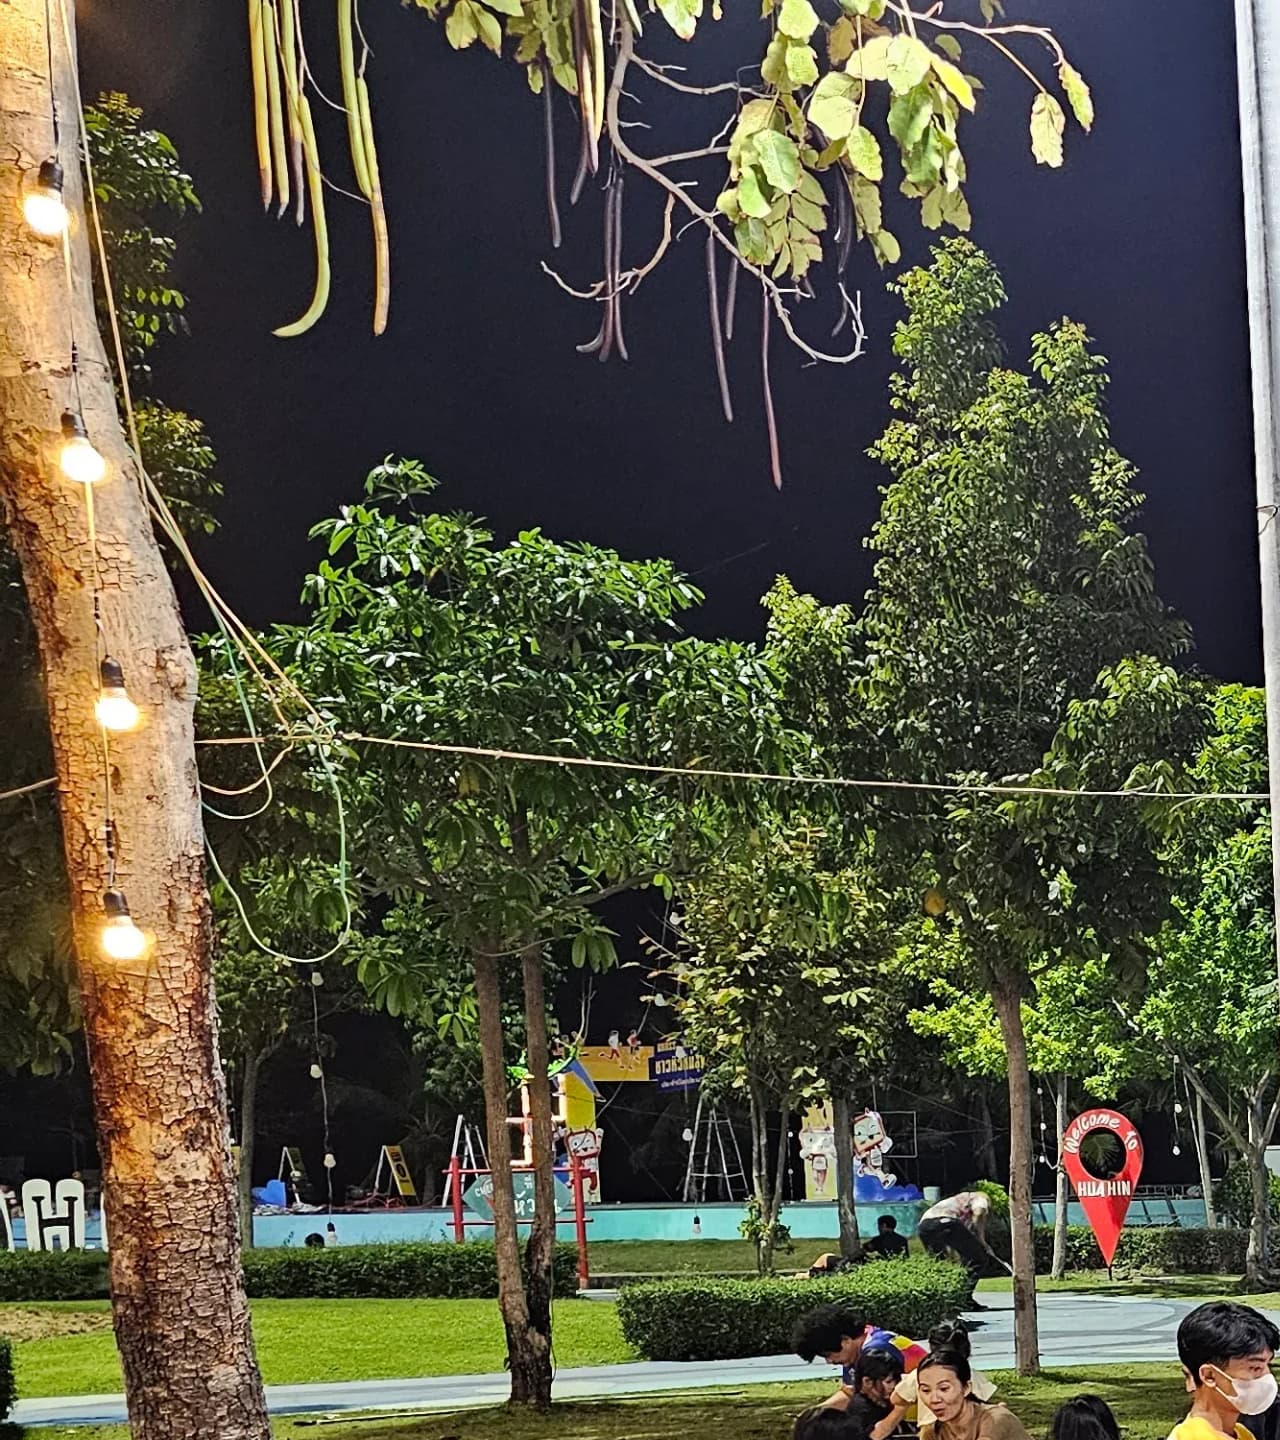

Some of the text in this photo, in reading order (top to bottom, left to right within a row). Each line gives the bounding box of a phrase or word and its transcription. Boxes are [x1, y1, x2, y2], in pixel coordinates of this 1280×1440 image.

[1064, 1113, 1120, 1154] Welcome
[1077, 1180, 1131, 1197] HUA HIN
